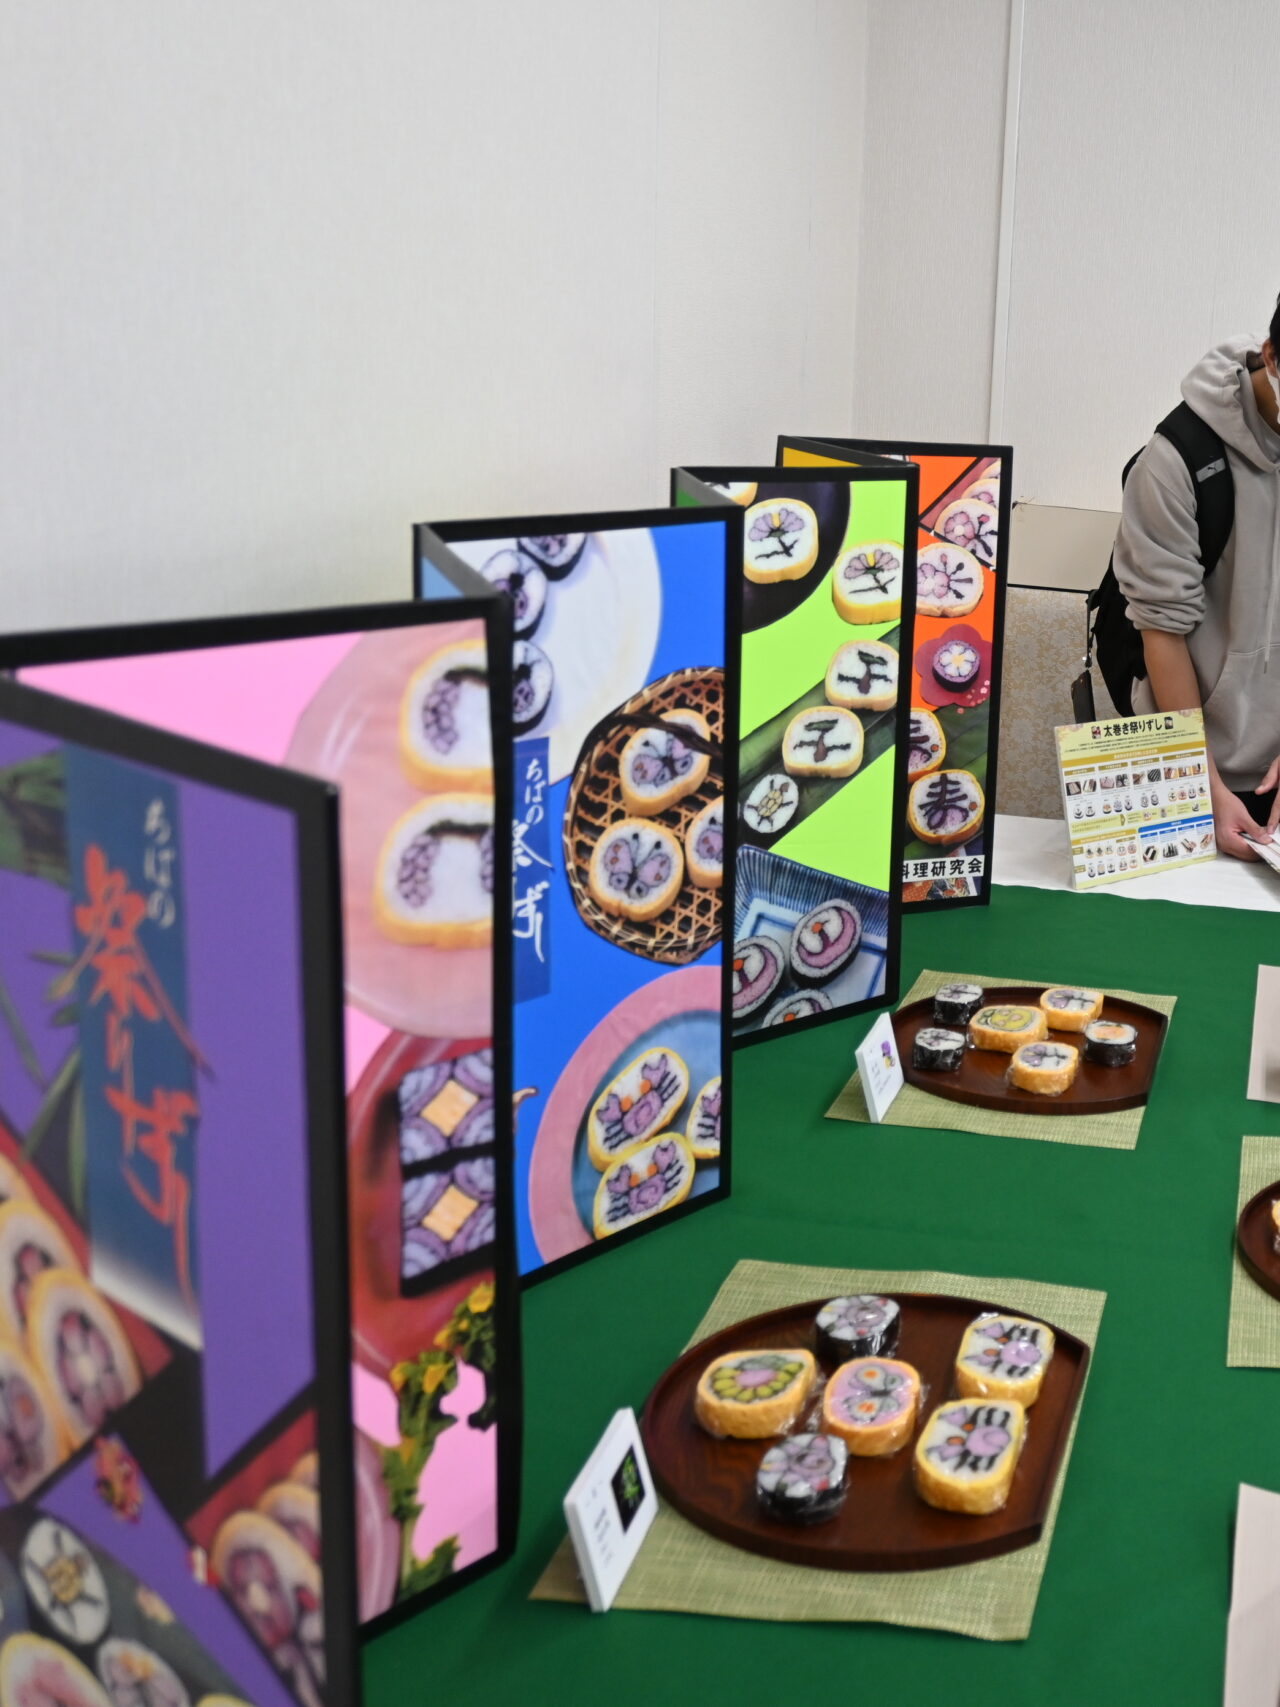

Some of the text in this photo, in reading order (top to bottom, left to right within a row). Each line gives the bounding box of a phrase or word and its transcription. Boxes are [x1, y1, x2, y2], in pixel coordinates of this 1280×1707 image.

[1103, 719, 1163, 737] 太巻き祭りずし
